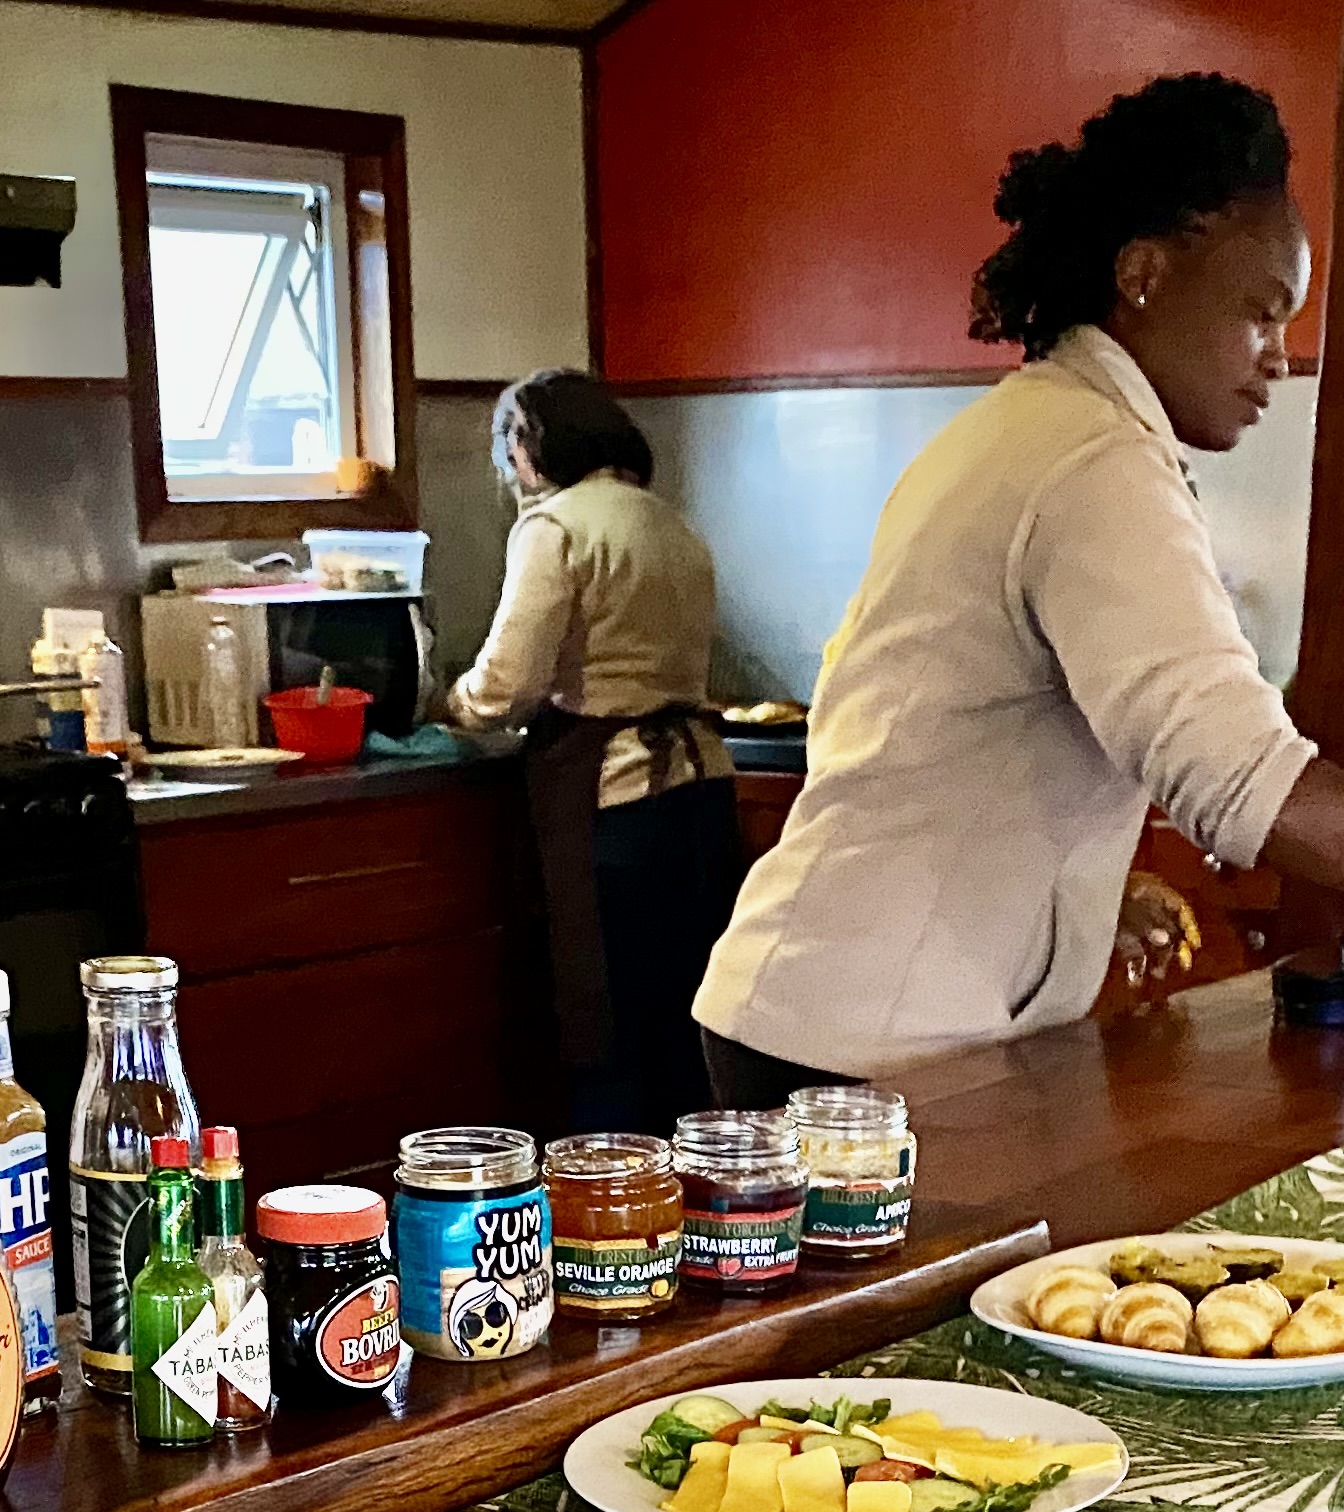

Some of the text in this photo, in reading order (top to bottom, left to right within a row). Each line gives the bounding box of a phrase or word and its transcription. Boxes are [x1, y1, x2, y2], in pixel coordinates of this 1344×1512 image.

[478, 1204, 542, 1246] YUM
[15, 1238, 51, 1265] SAUCE
[476, 1234, 541, 1278] YUM
[683, 1233, 777, 1256] STRAWBERRY
[556, 1257, 674, 1282] SEVILLE ORANGE
[744, 1254, 775, 1268] EXTRA
[568, 1283, 650, 1297] Choice Grade
[361, 1307, 396, 1334] BEEFY
